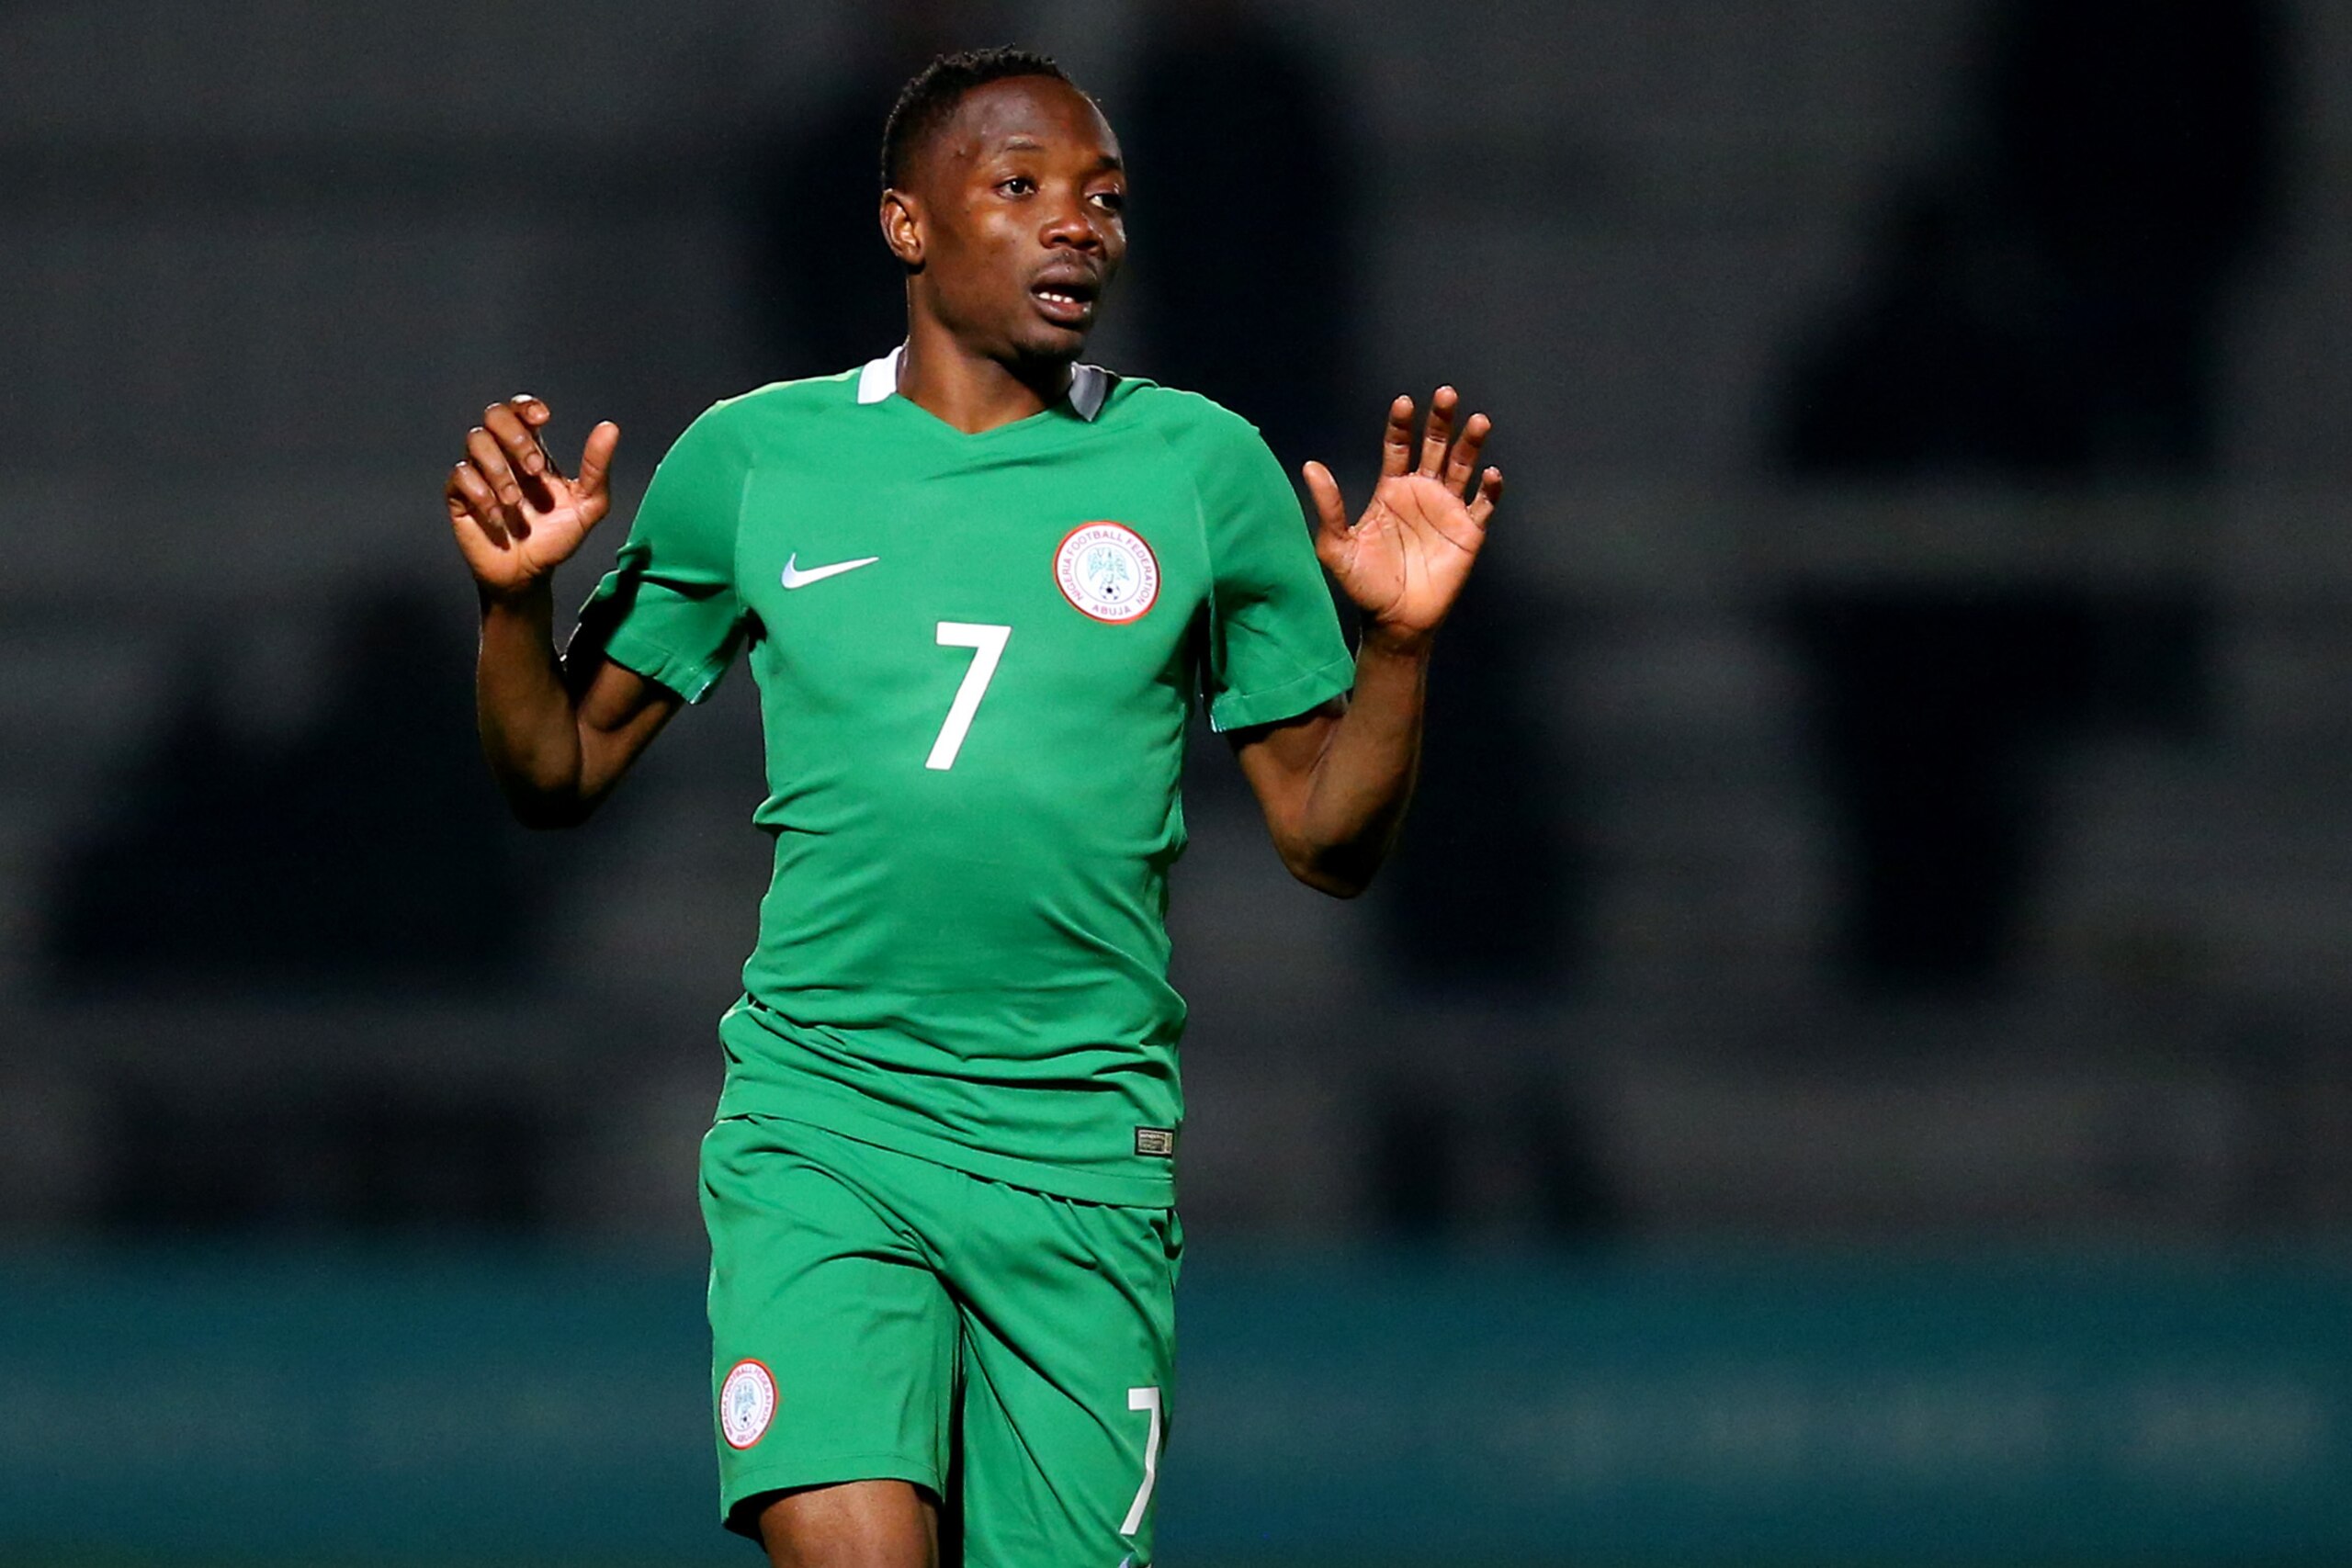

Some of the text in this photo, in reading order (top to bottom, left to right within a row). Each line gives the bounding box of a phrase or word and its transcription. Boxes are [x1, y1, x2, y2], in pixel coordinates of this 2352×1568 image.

[1062, 530, 1153, 605] NIGERIA FOOTBALL FEDERATION
[1091, 604, 1132, 616] ABUJA
[924, 621, 1012, 772] 7
[1120, 1387, 1160, 1535] 7
